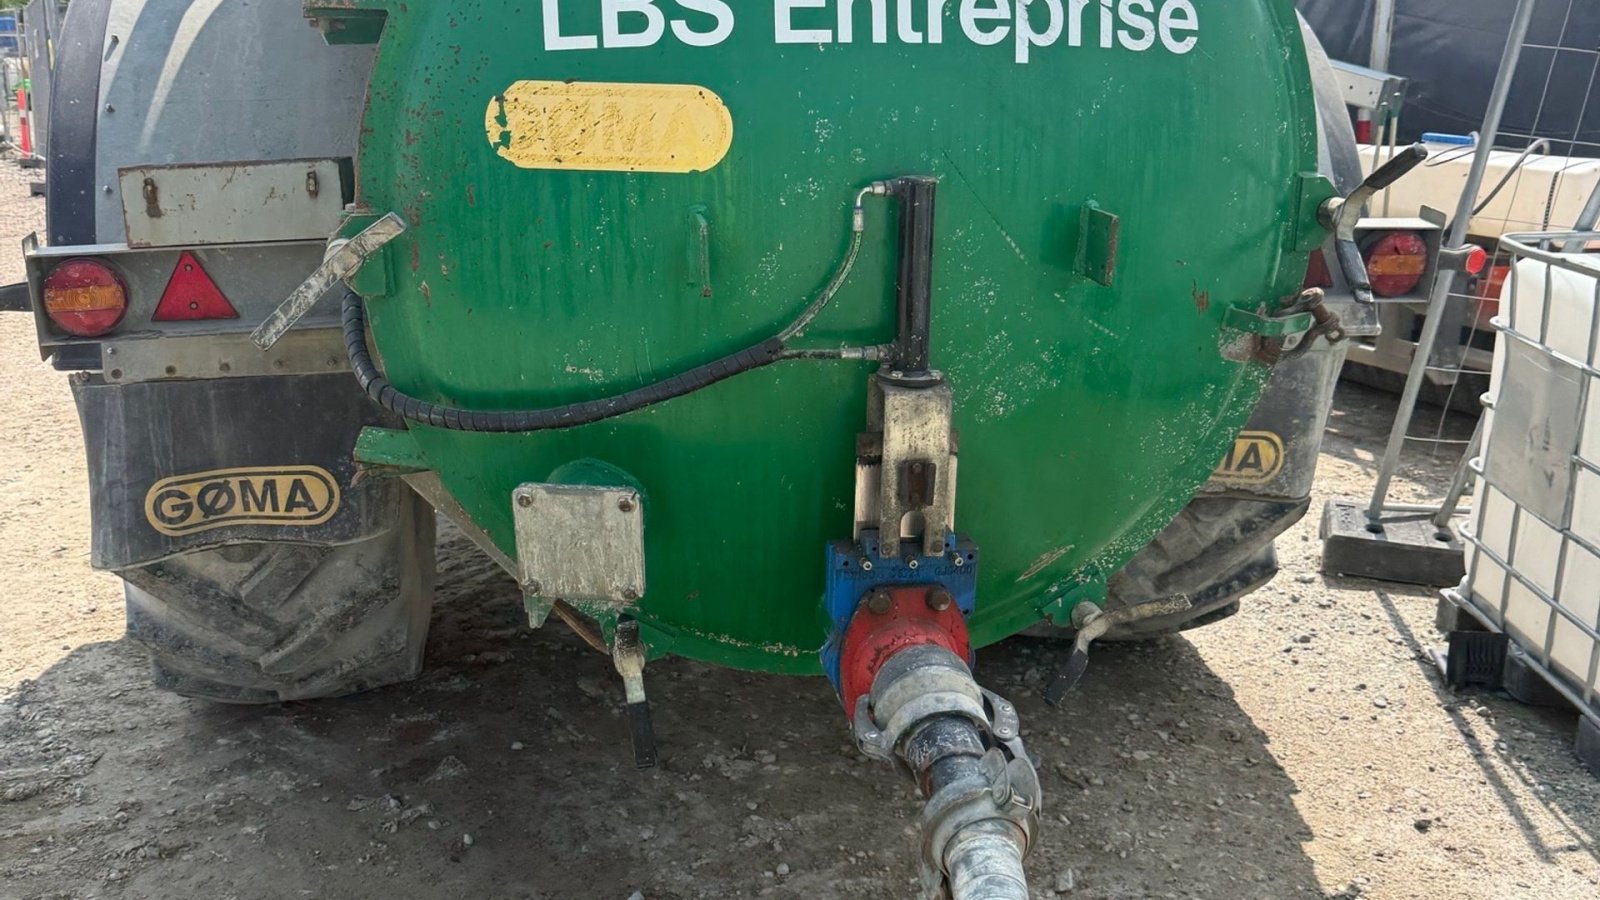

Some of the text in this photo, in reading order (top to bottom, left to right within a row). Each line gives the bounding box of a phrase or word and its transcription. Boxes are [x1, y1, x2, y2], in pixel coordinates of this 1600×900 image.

[542, 0, 1198, 64] LBS Entreprise
[153, 479, 318, 525] GØMA
